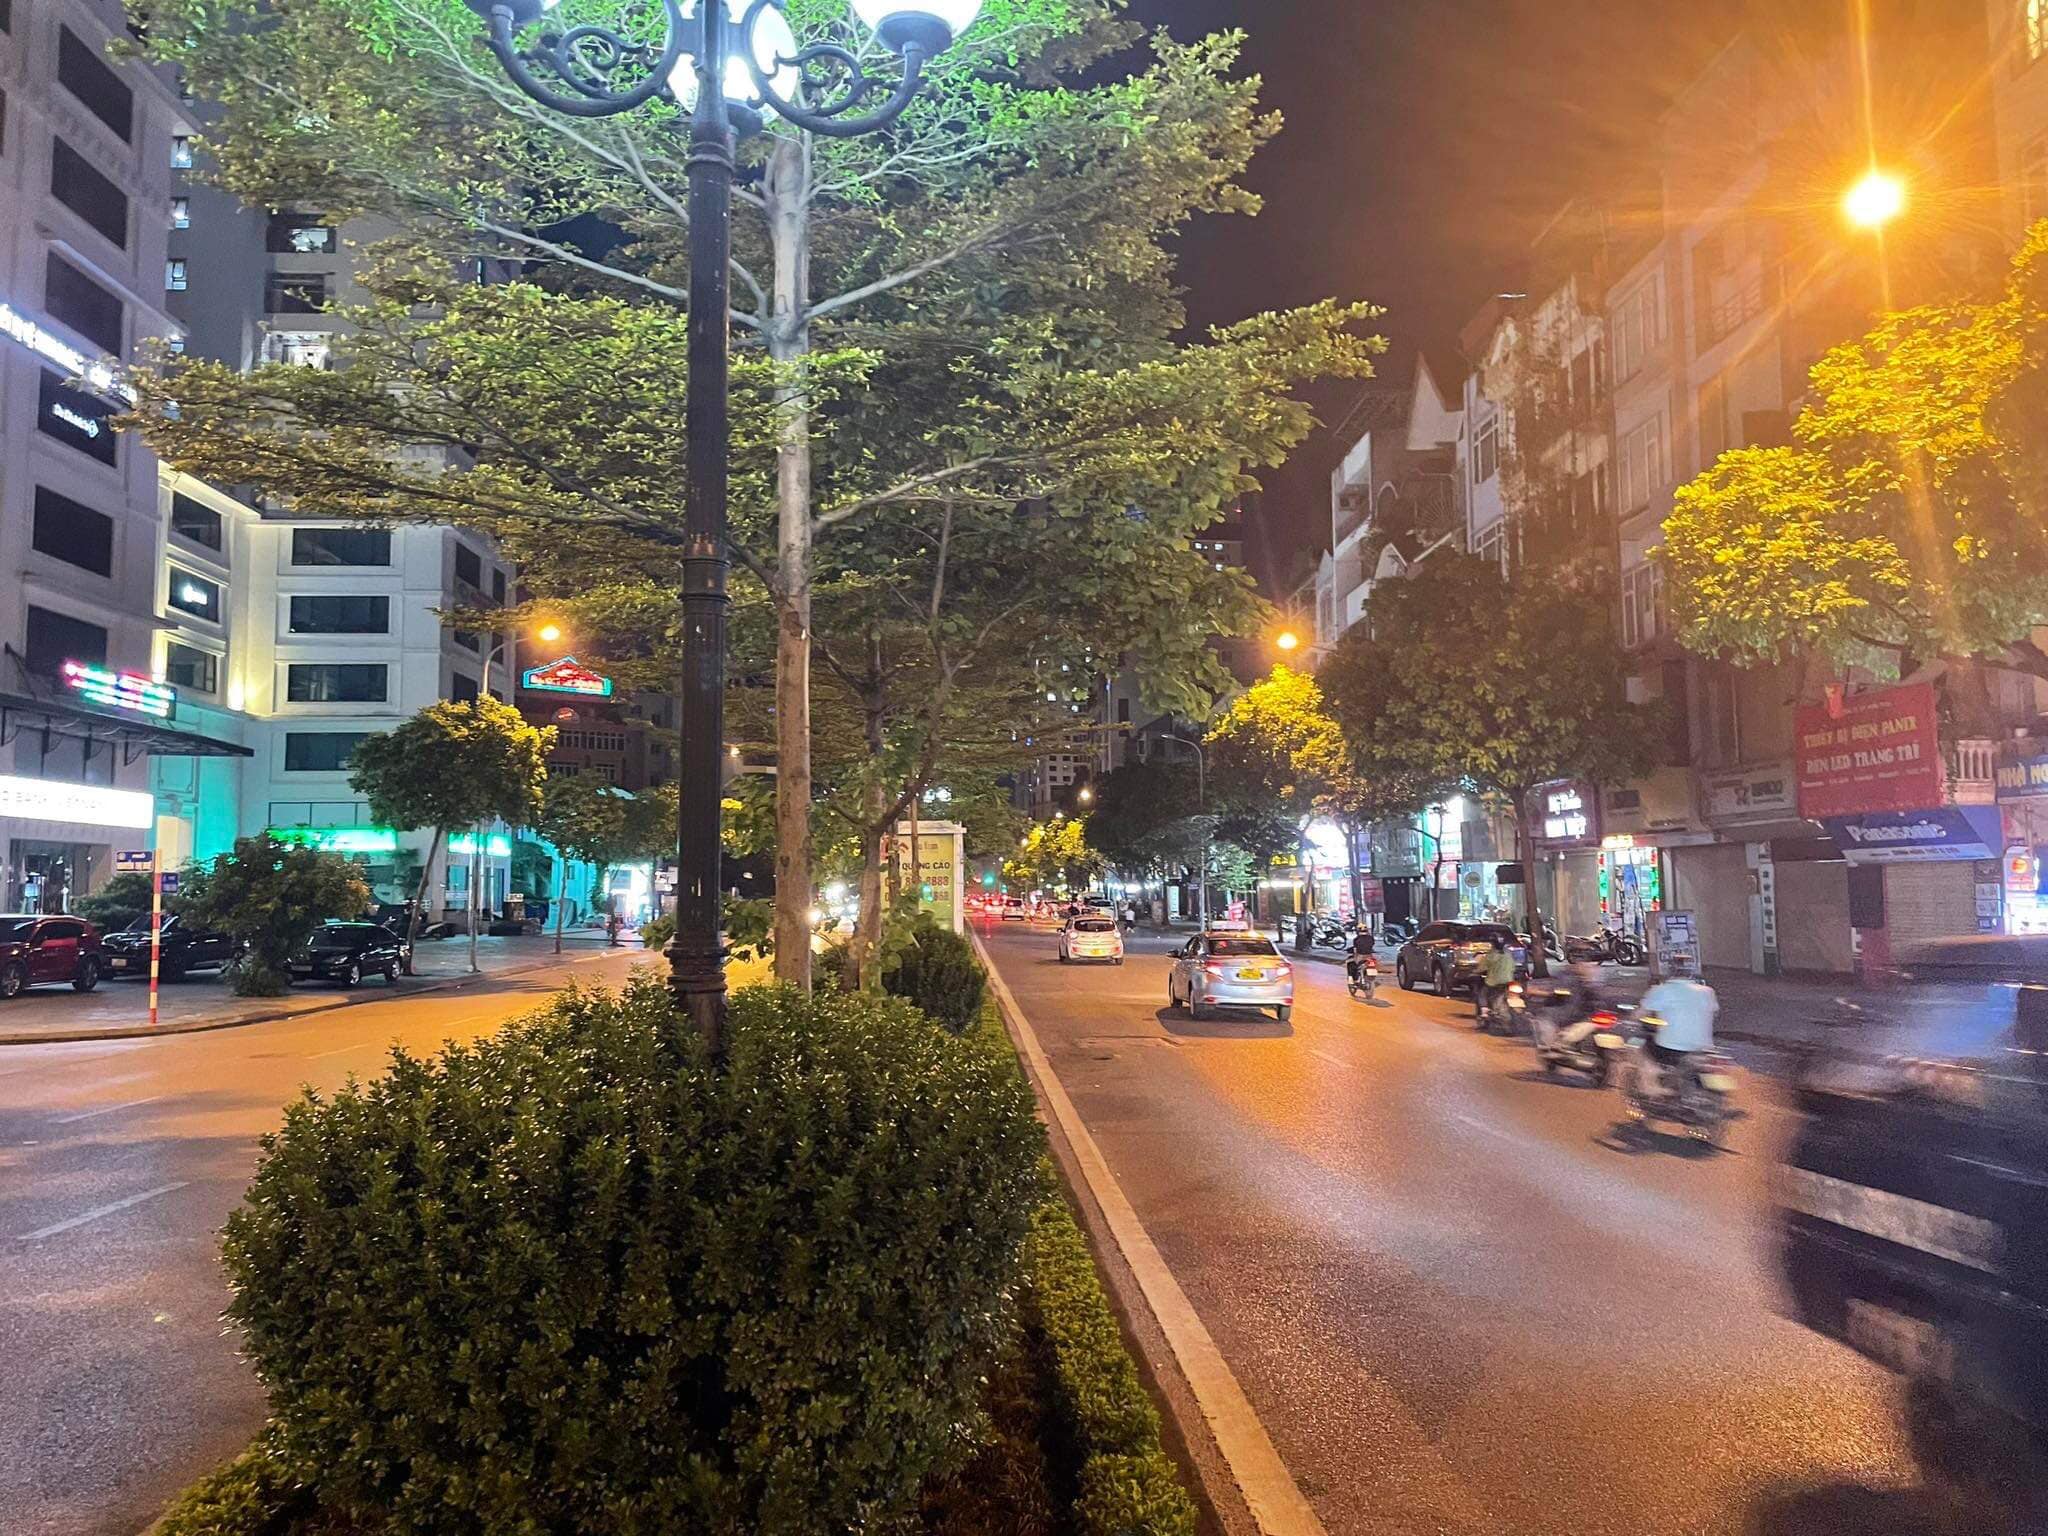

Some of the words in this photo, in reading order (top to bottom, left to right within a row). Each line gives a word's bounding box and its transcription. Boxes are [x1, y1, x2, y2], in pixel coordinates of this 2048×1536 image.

[1853, 745, 1894, 768] TRANG
[1845, 818, 1947, 842] Panasonic
[901, 862, 930, 871] QUNG
